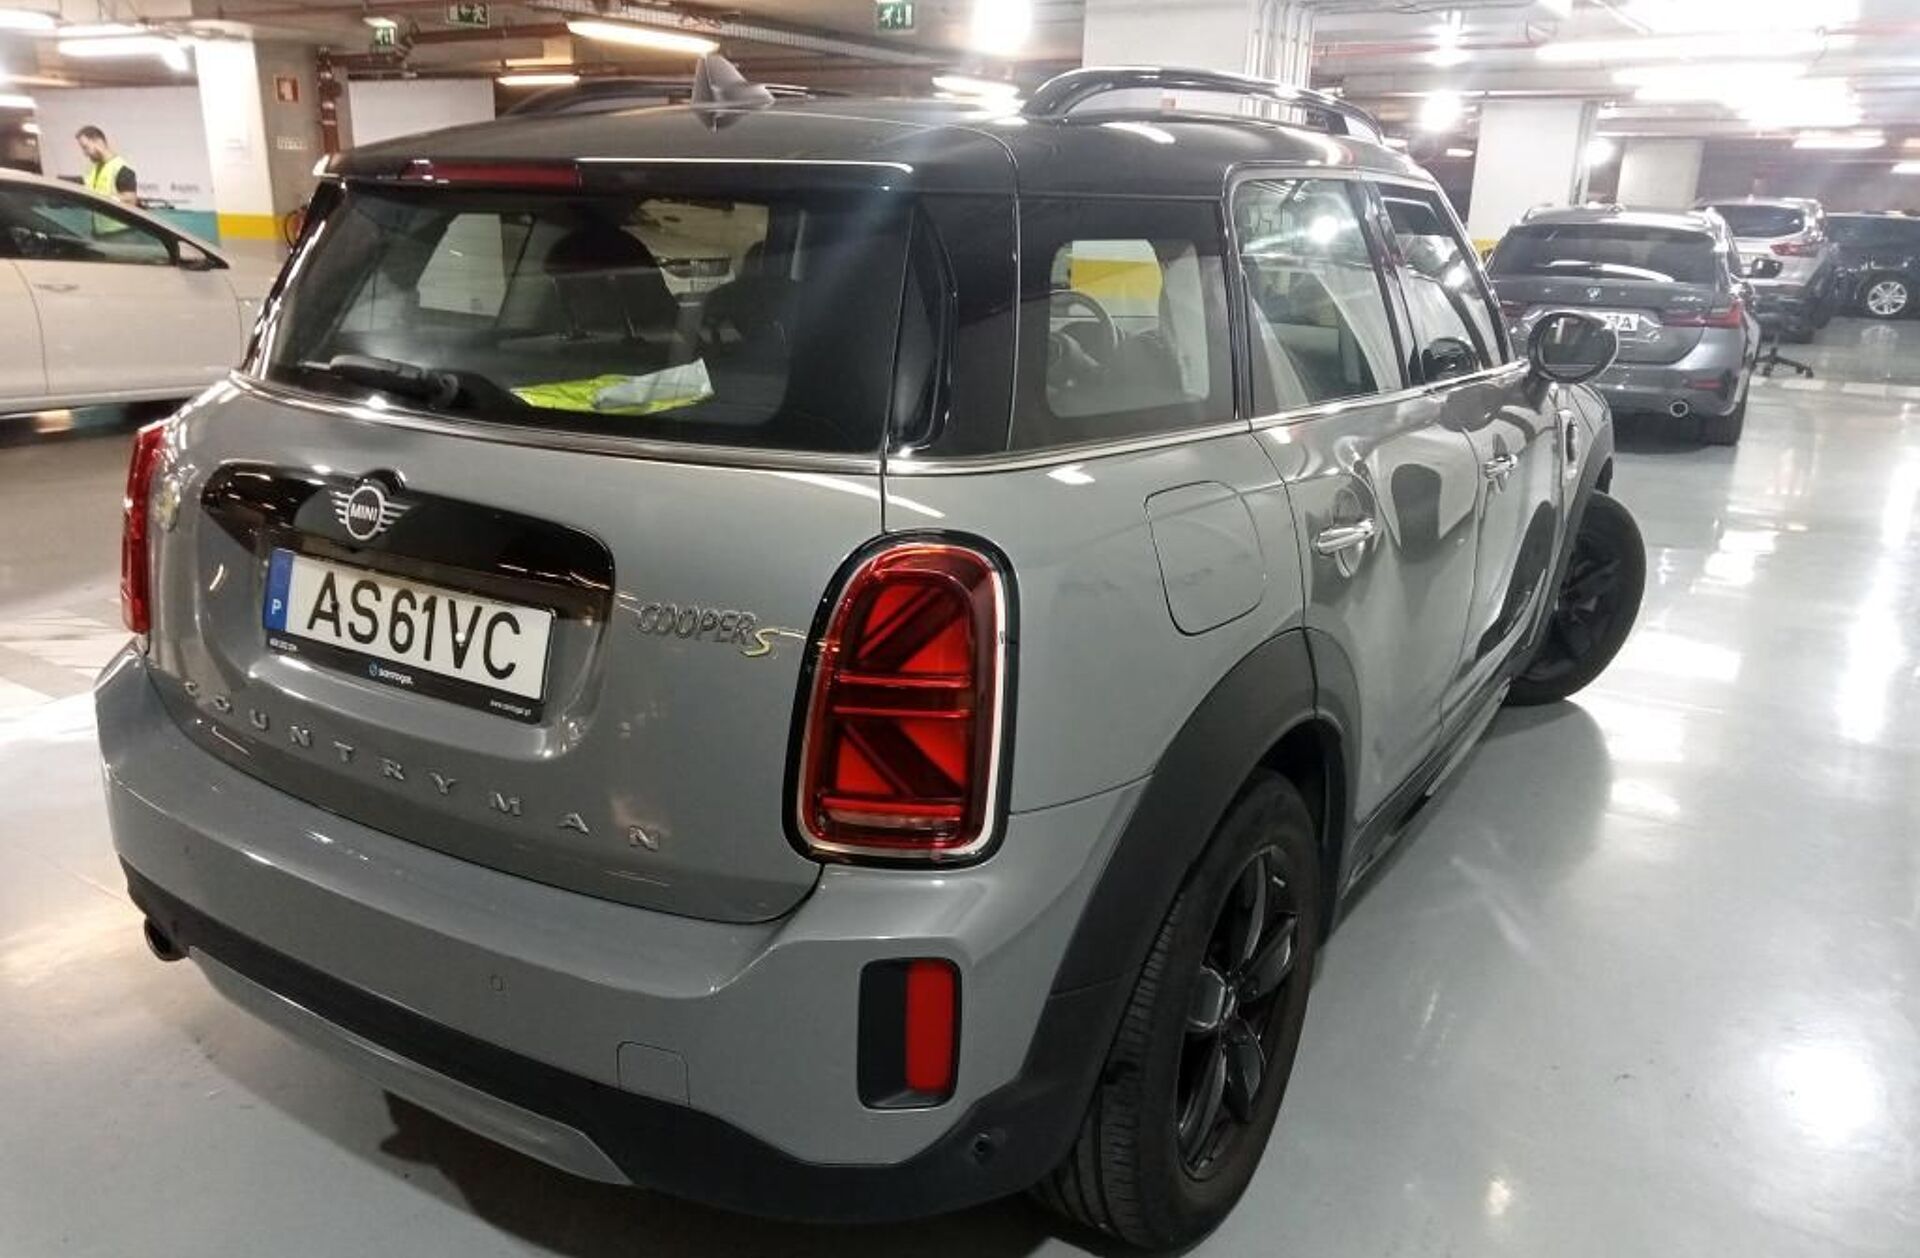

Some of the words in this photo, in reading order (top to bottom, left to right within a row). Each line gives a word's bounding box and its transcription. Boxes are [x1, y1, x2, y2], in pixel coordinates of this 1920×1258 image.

[350, 504, 378, 521] MINI
[271, 597, 282, 615] P
[307, 571, 521, 680] AS61VC
[639, 602, 756, 645] COOPER
[740, 628, 779, 657] S
[184, 680, 660, 851] COUNTRYMAN
